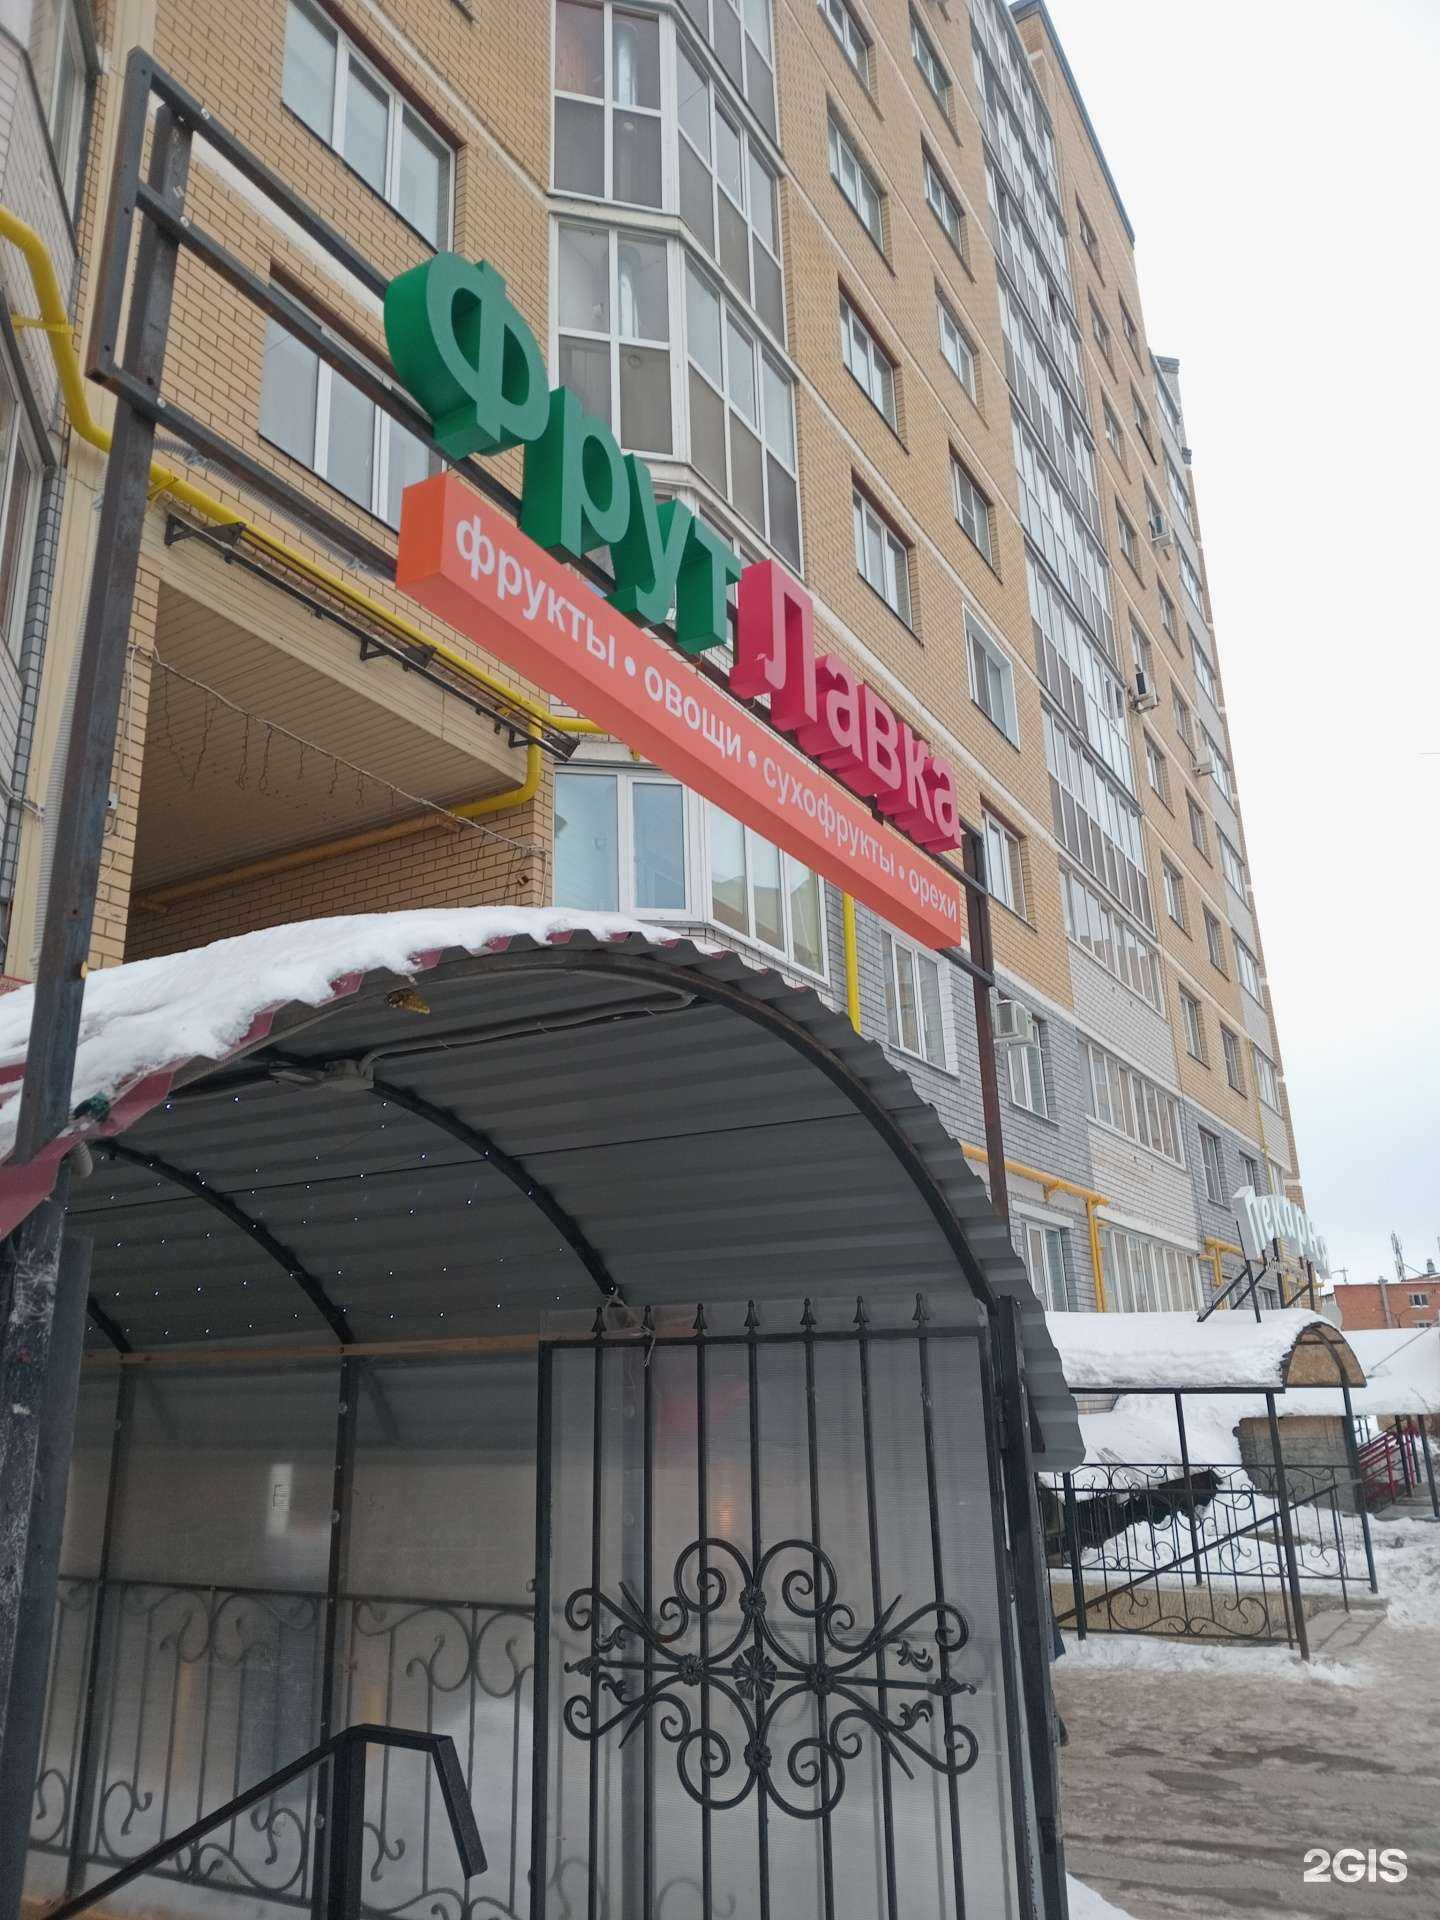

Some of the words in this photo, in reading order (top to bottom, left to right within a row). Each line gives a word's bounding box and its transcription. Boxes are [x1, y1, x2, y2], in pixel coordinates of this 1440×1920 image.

[455, 515, 616, 669] фрукты
[644, 666, 742, 763] овощи
[763, 757, 895, 879] сухофрукты
[908, 869, 957, 923] орехи
